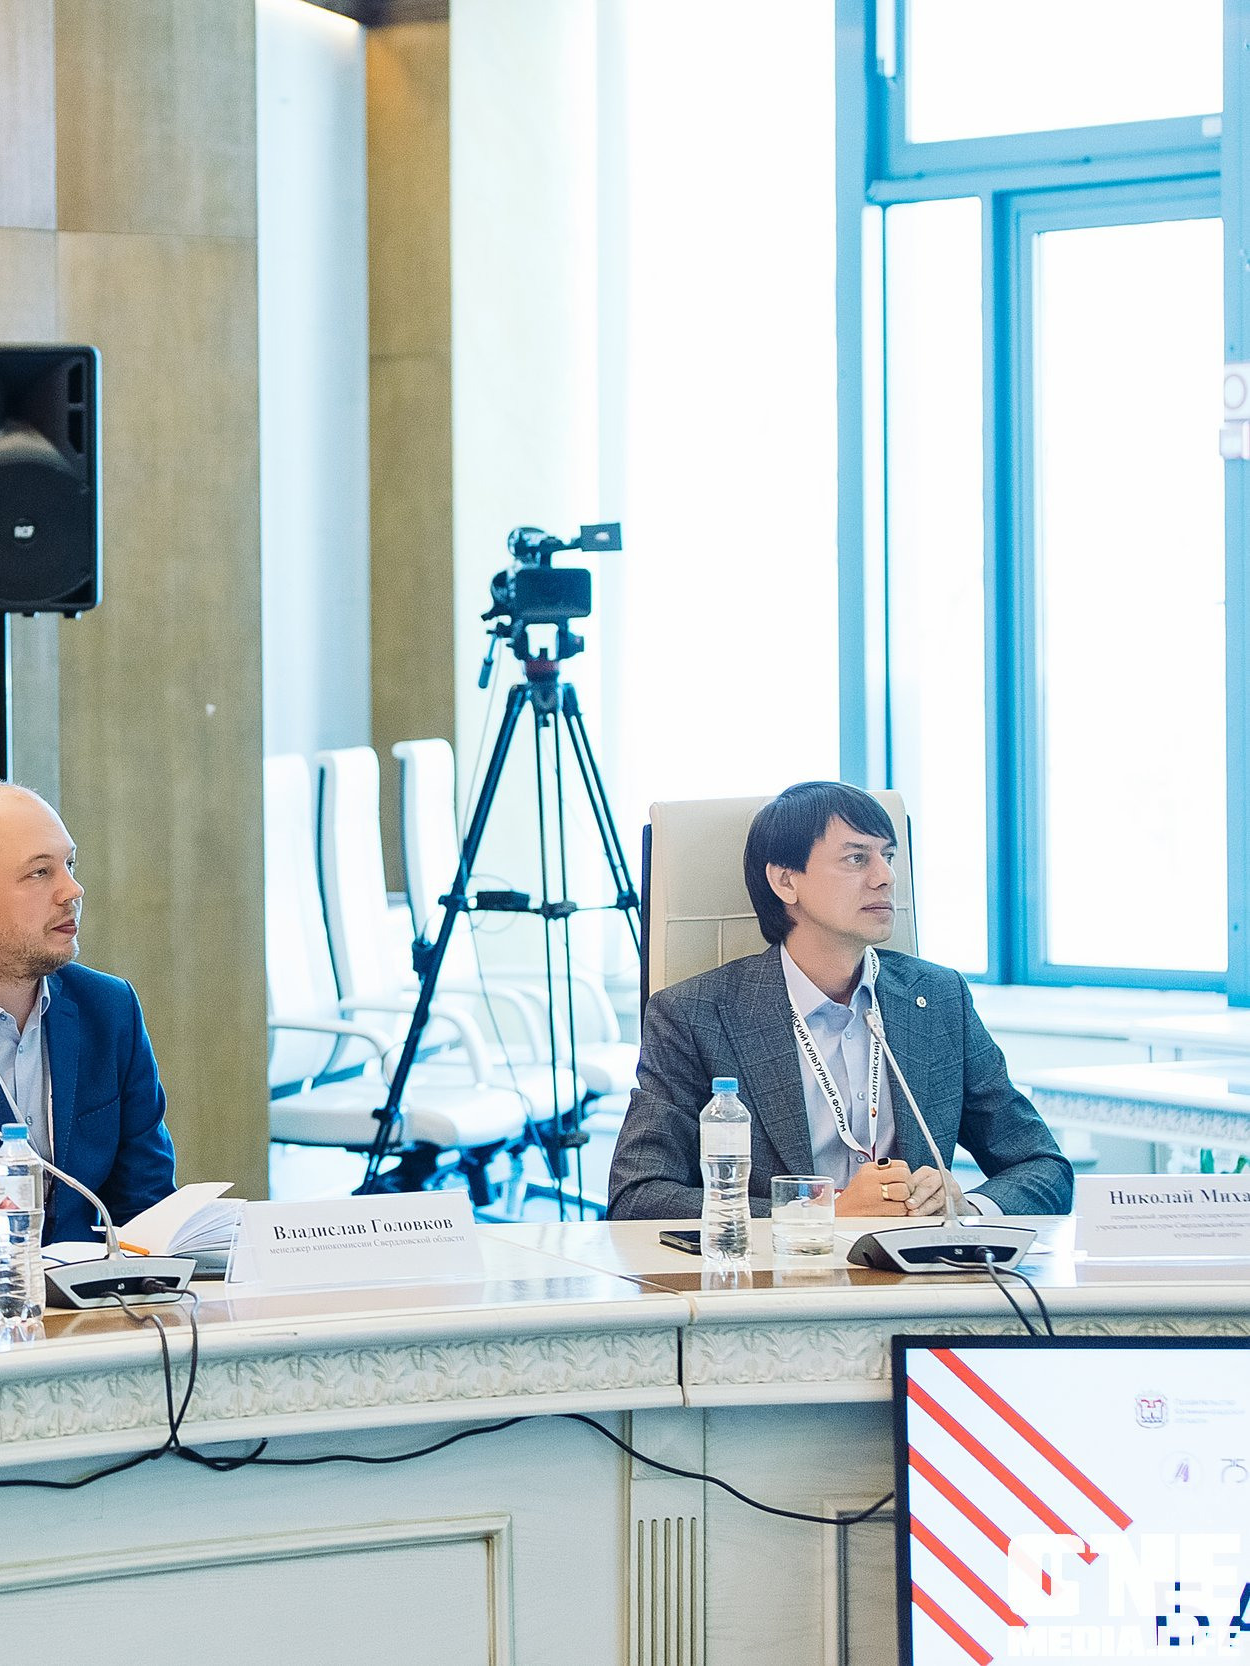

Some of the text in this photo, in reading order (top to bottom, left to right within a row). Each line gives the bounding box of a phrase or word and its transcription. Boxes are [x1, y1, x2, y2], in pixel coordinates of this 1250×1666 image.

[803, 1042, 837, 1098] КУЛЬТУРНЫЙ
[831, 1098, 847, 1133] ФОРУМ
[1109, 1189, 1194, 1205] Николай
[273, 1216, 454, 1241] Владислав Головков
